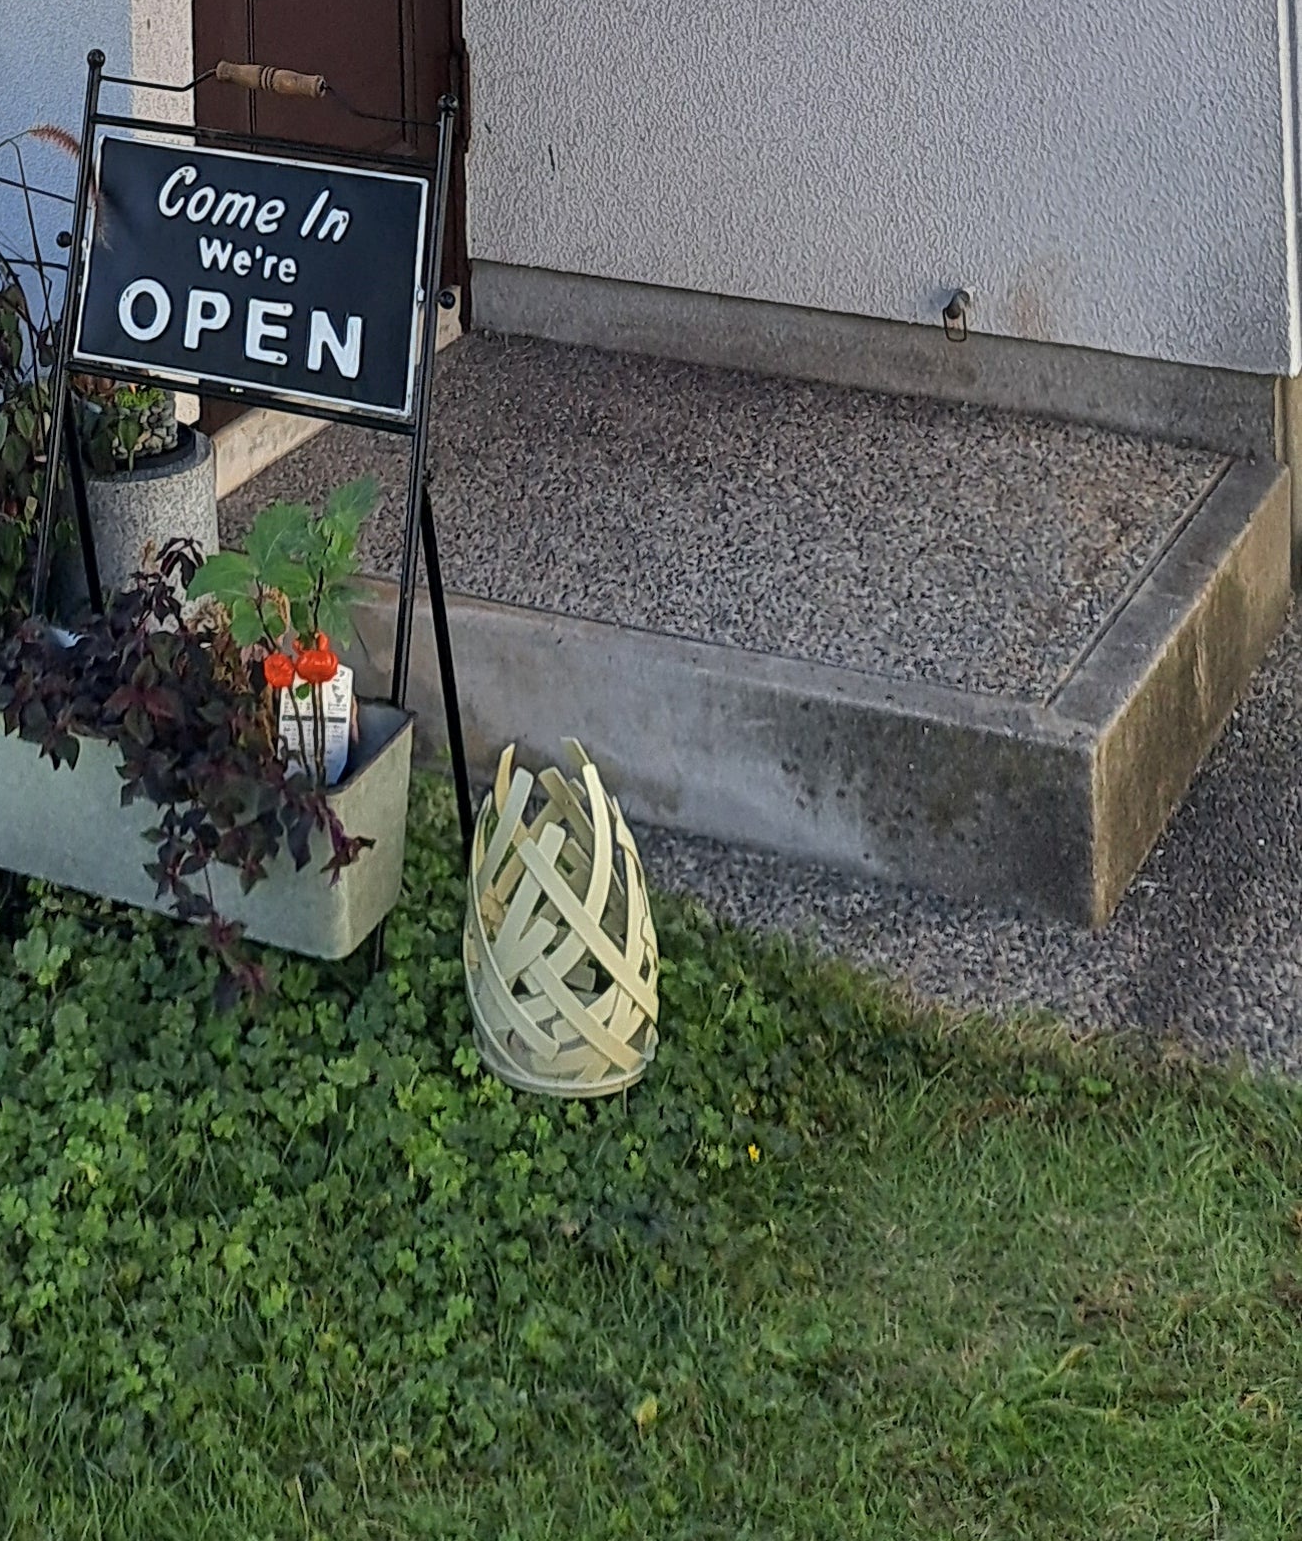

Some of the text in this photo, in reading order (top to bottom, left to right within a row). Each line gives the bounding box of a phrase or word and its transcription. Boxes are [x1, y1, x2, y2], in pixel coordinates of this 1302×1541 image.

[158, 165, 350, 242] Come In
[199, 236, 298, 284] We're
[118, 277, 364, 380] OPEN
